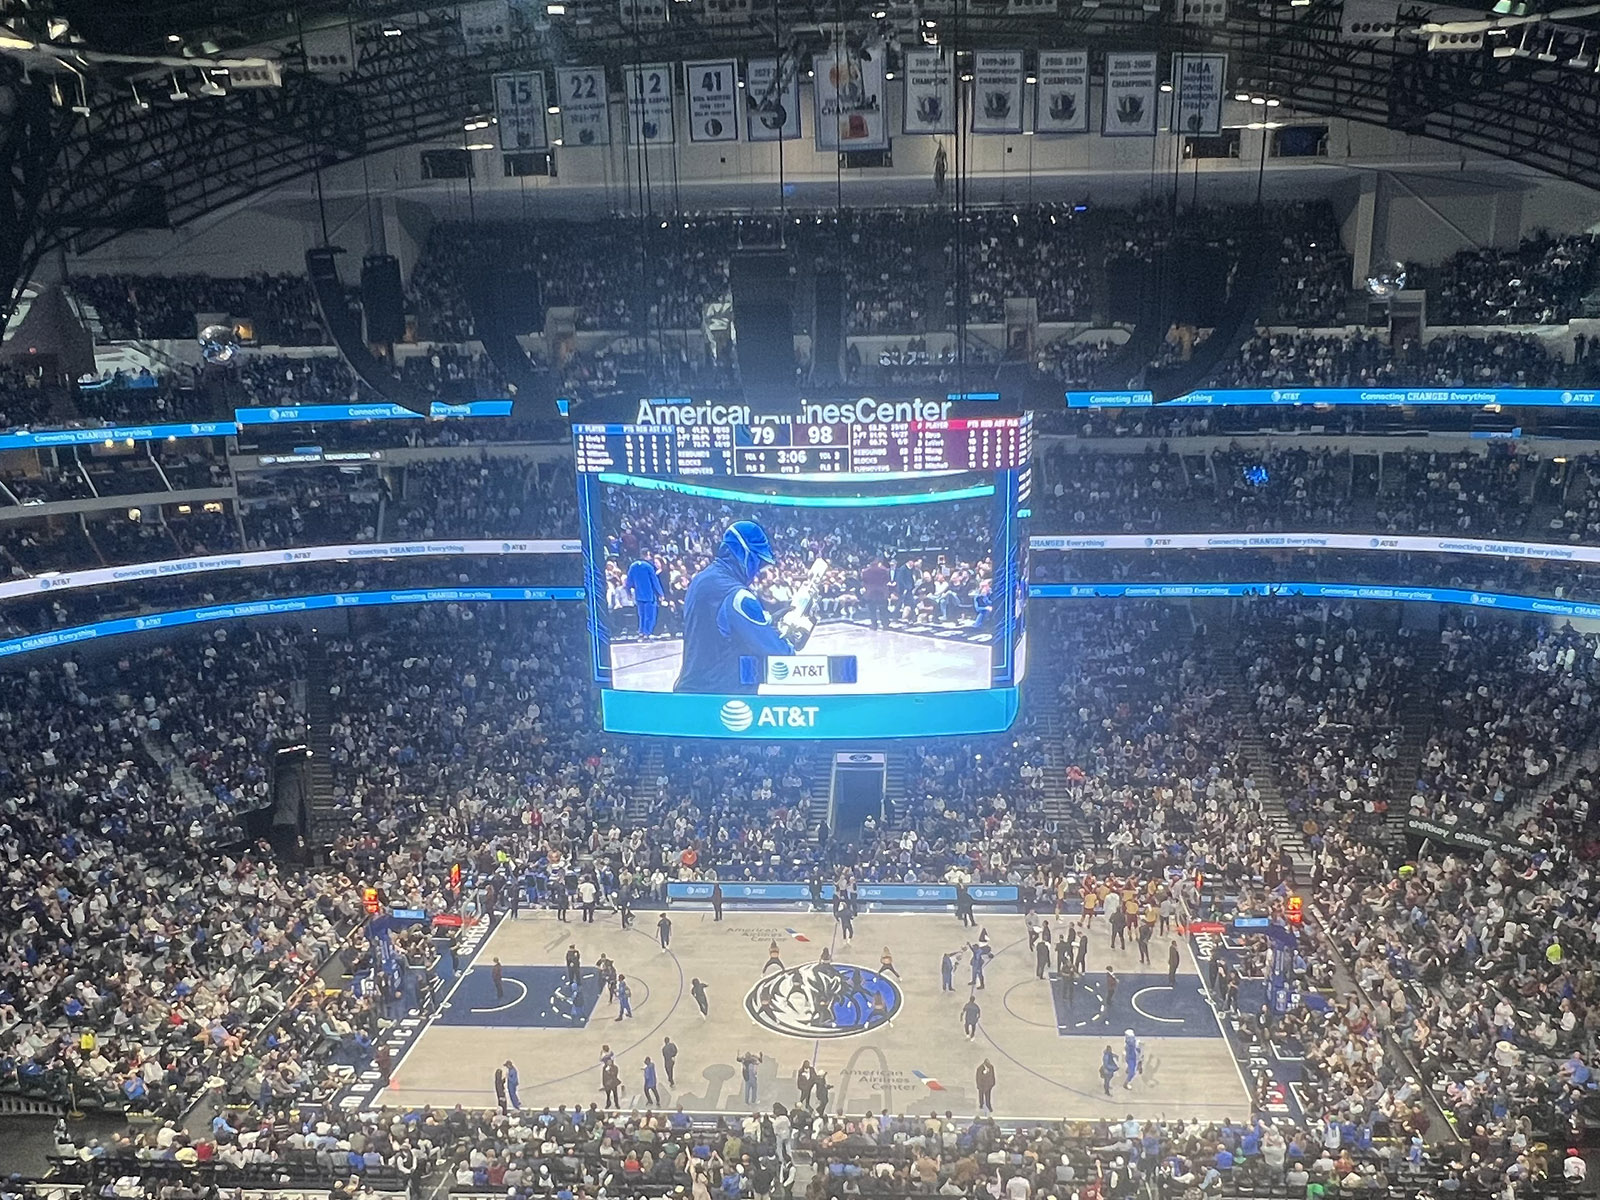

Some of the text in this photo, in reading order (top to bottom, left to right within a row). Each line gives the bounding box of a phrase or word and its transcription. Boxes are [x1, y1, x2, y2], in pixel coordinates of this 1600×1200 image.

[1187, 62, 1211, 74] NBA
[571, 75, 596, 99] 22
[637, 72, 661, 95] 12
[702, 72, 721, 92] 41
[507, 80, 532, 104] 15
[1089, 395, 1131, 404] Connecting
[1281, 392, 1300, 400] AT&T
[1360, 392, 1496, 403] Connecting CHANGES Everything
[1573, 393, 1595, 402] AT&T
[280, 409, 299, 418] AT&T
[348, 407, 390, 417] Connecting
[925, 421, 949, 429] PLAYER
[35, 433, 76, 443] Connecting
[114, 428, 152, 438] Everything
[750, 426, 776, 445] 79
[807, 425, 833, 445] 98
[759, 452, 765, 461] 4
[777, 450, 807, 464] 3:06
[1067, 539, 1105, 548] Everything
[1154, 538, 1172, 546] AT&T
[1208, 537, 1328, 547] Connecting CHANGES Everything
[1380, 539, 1399, 547] AT&T
[348, 543, 465, 557] Connecting CHANGES Everything
[1438, 542, 1573, 558] Connecting CHANGES Everything
[113, 558, 241, 580] Connecting CHANGES Everything
[51, 578, 71, 588] AT&T
[391, 593, 426, 601] Connecting
[459, 590, 492, 600] Everything
[1125, 586, 1160, 596] Connecting
[1194, 586, 1229, 596] Everything
[1320, 587, 1433, 600] Connecting CHANGES Everything
[1479, 596, 1496, 604] AT&T
[196, 600, 306, 618] Connecting CHANGES Everything
[1532, 602, 1573, 614] Connecting
[145, 618, 162, 626] AT&T
[21, 629, 97, 648] CHANGES Everything
[792, 665, 825, 677] AT&T
[757, 706, 820, 727] AT&T
[858, 1076, 910, 1084] Airlines
